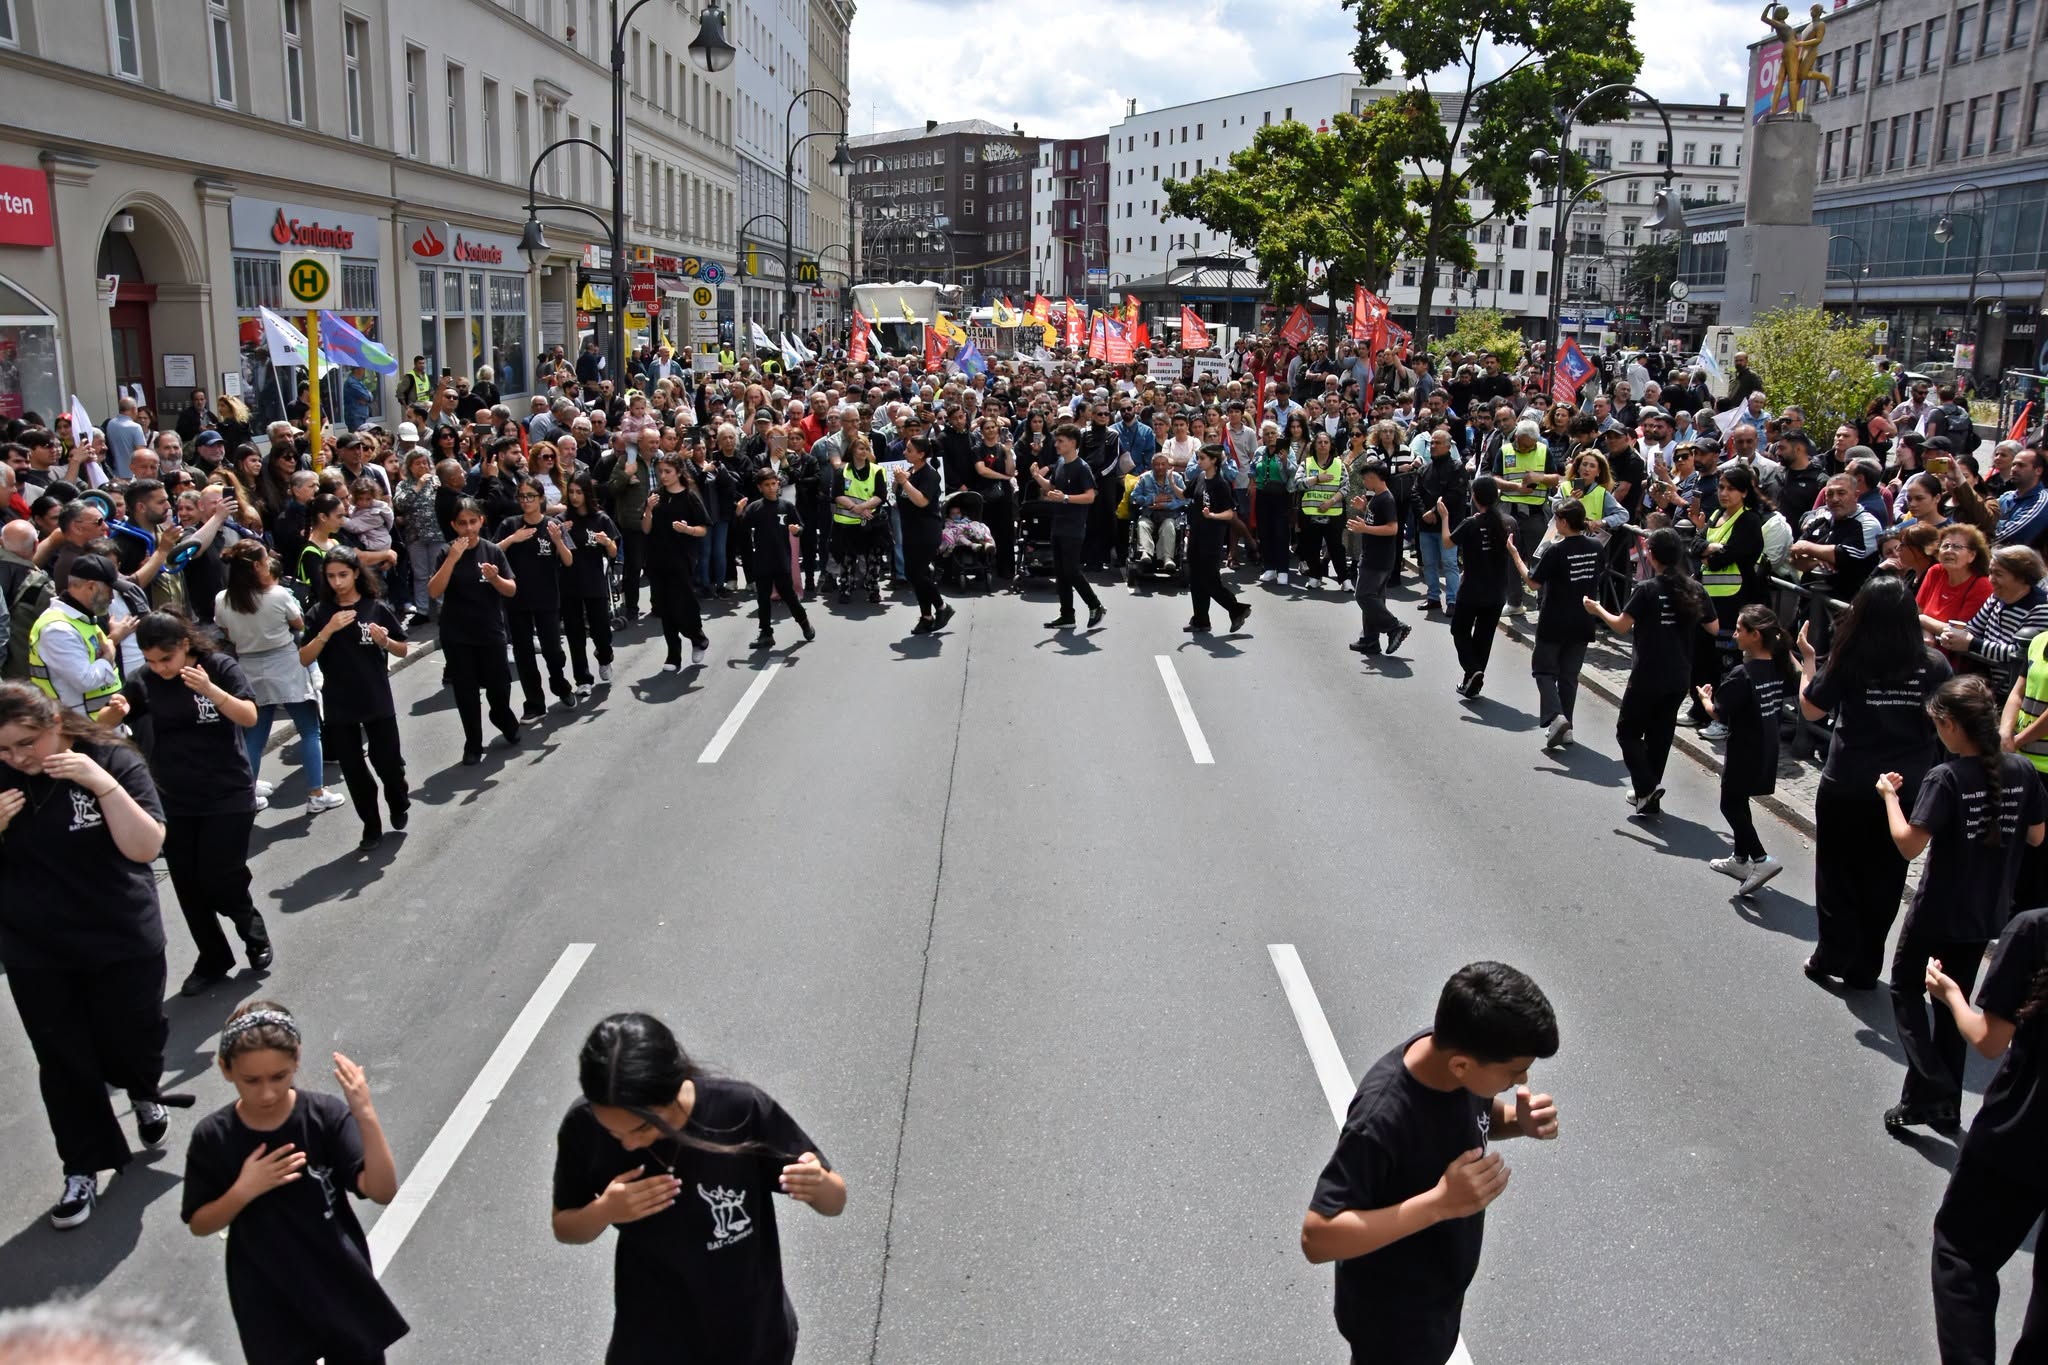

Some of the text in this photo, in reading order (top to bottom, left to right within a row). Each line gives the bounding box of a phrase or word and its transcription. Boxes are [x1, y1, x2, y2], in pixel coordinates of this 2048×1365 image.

[292, 218, 354, 249] Santander
[1692, 229, 1728, 245] KARSTADT
[465, 240, 503, 264] Santander
[298, 269, 318, 292] H
[698, 289, 707, 302] H
